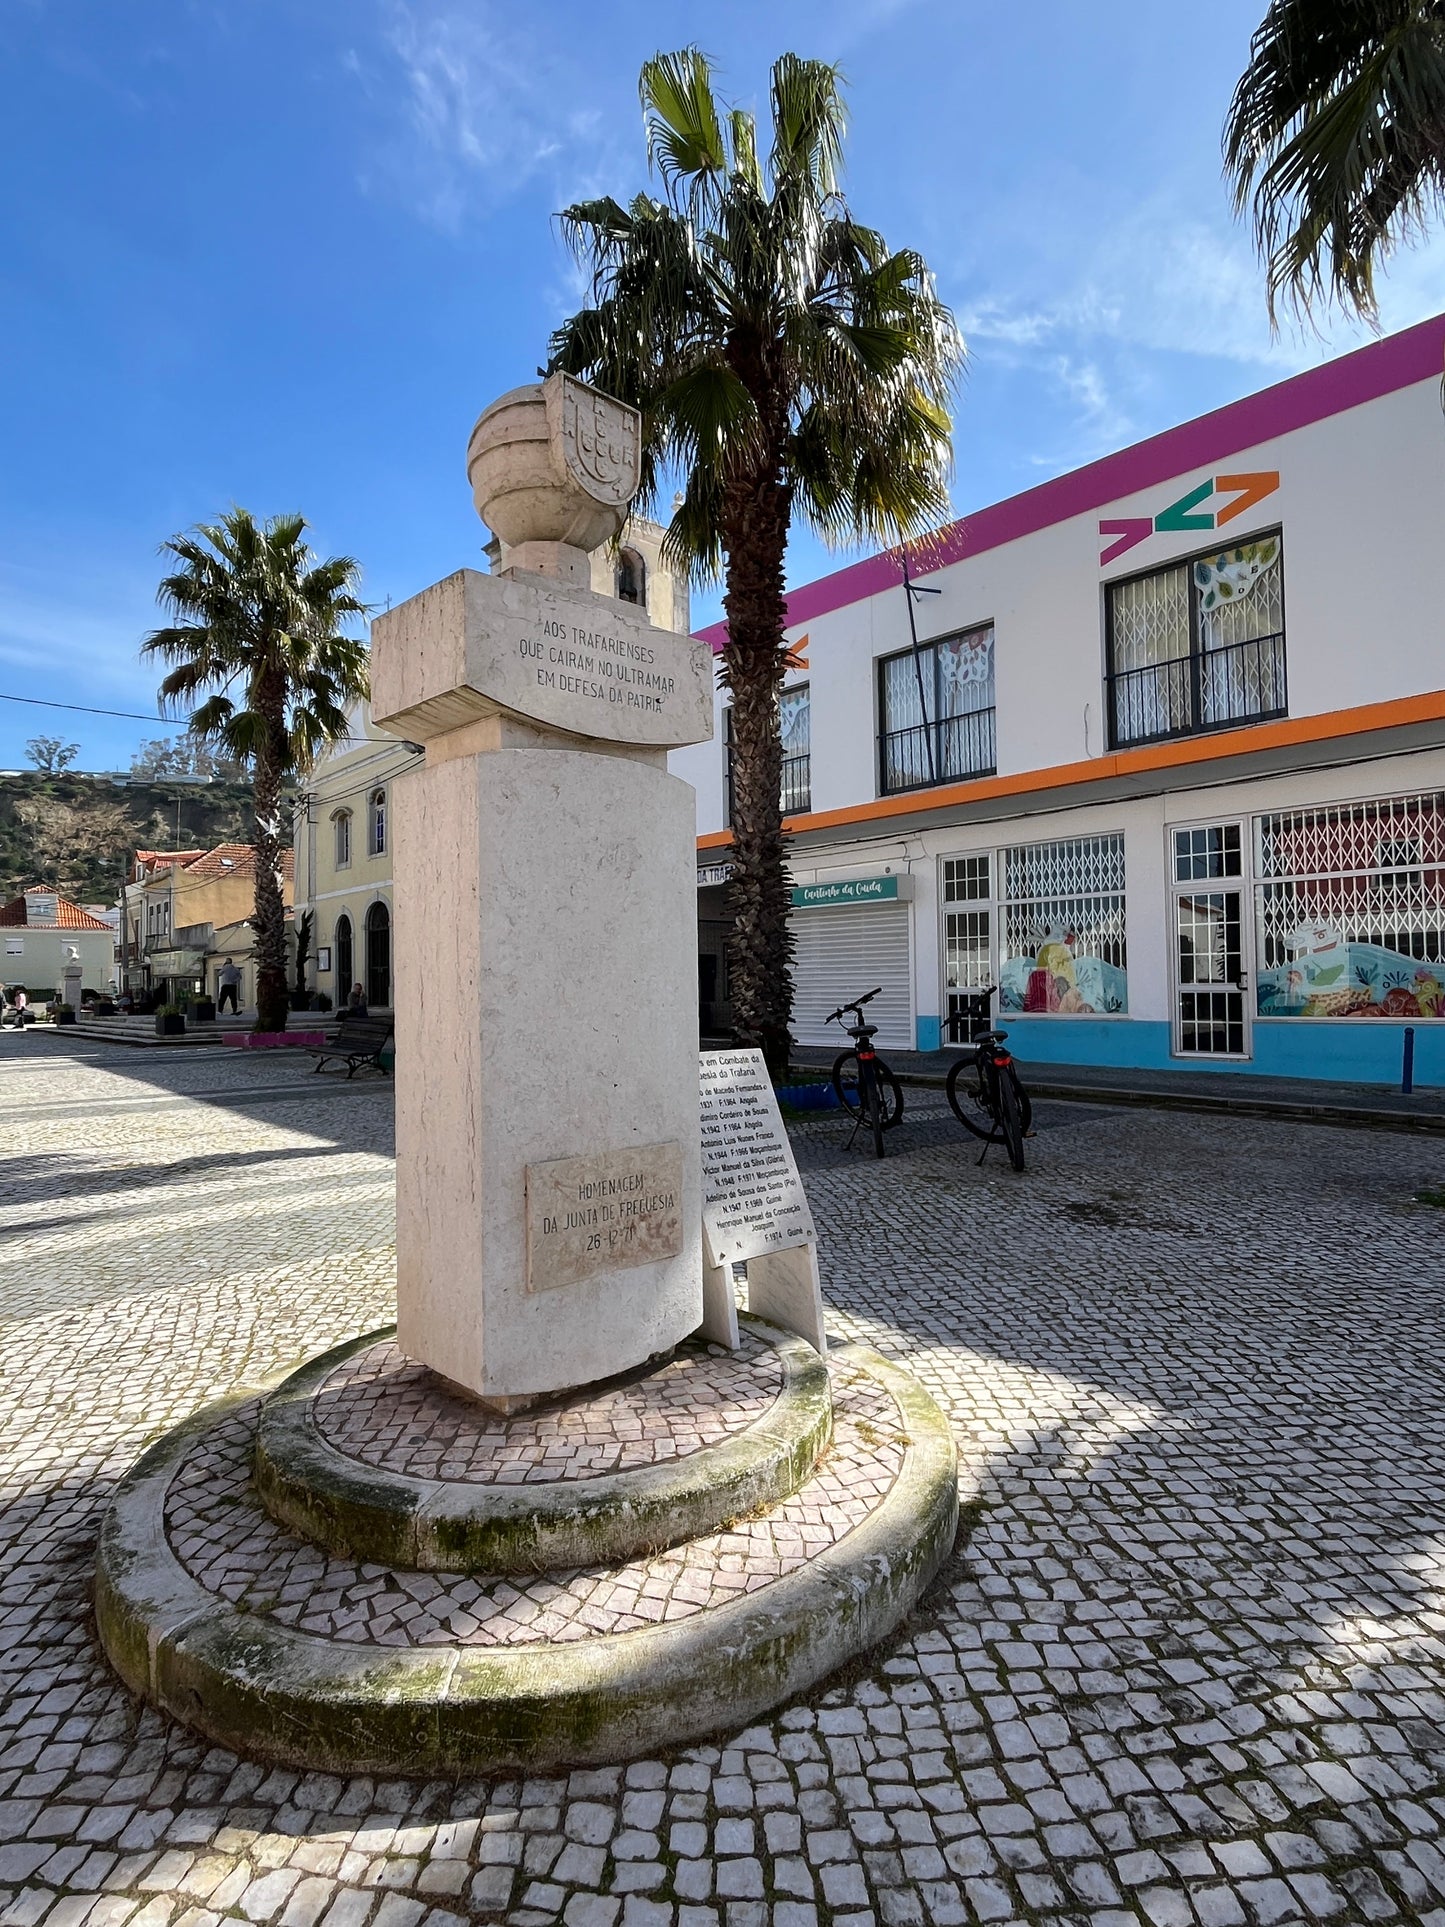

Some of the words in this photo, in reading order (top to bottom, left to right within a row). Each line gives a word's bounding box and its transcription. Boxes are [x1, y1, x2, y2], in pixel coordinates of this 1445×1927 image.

[544, 620, 567, 640] AOS
[572, 627, 655, 664] TRAFARIENSES
[519, 638, 544, 660] QUE
[550, 648, 594, 673] CAIRAM
[598, 660, 613, 678] NO
[616, 665, 675, 694] ULTRAMAR
[537, 669, 555, 688] EM
[559, 674, 604, 700] DEFESA
[609, 687, 624, 704] DA
[627, 692, 662, 714] PATRIA
[804, 885, 840, 900] Cantinho
[842, 884, 855, 896] da
[706, 1059, 718, 1067] em
[719, 1056, 750, 1065] Combate
[751, 1055, 760, 1063] da
[719, 1070, 728, 1079] da
[729, 1068, 756, 1077] Trafaria
[705, 1088, 712, 1096] de
[699, 1100, 713, 1109] .1931
[739, 1096, 758, 1106] Angola
[719, 1111, 743, 1120] Cordeiro
[744, 1120, 763, 1130] Angola
[721, 1162, 742, 1172] Manuel
[742, 1161, 750, 1169] da
[750, 1158, 765, 1168] Silva
[738, 1173, 756, 1183] F.1971
[578, 1174, 644, 1201] HOMENAGEM
[706, 1193, 728, 1204] Adelino
[728, 1190, 736, 1199] de
[756, 1185, 767, 1193] dos
[543, 1217, 558, 1235] DA
[563, 1208, 598, 1230] JUNTA
[602, 1204, 616, 1222] DE
[619, 1193, 675, 1218] FREGUESIA
[722, 1202, 742, 1214] N.1947
[716, 1218, 743, 1230] Henrique
[743, 1212, 764, 1223] Manuel
[764, 1210, 772, 1218] da
[772, 1204, 801, 1216] Conceição
[751, 1220, 775, 1233] Joaquim
[764, 1232, 782, 1242] F.1974
